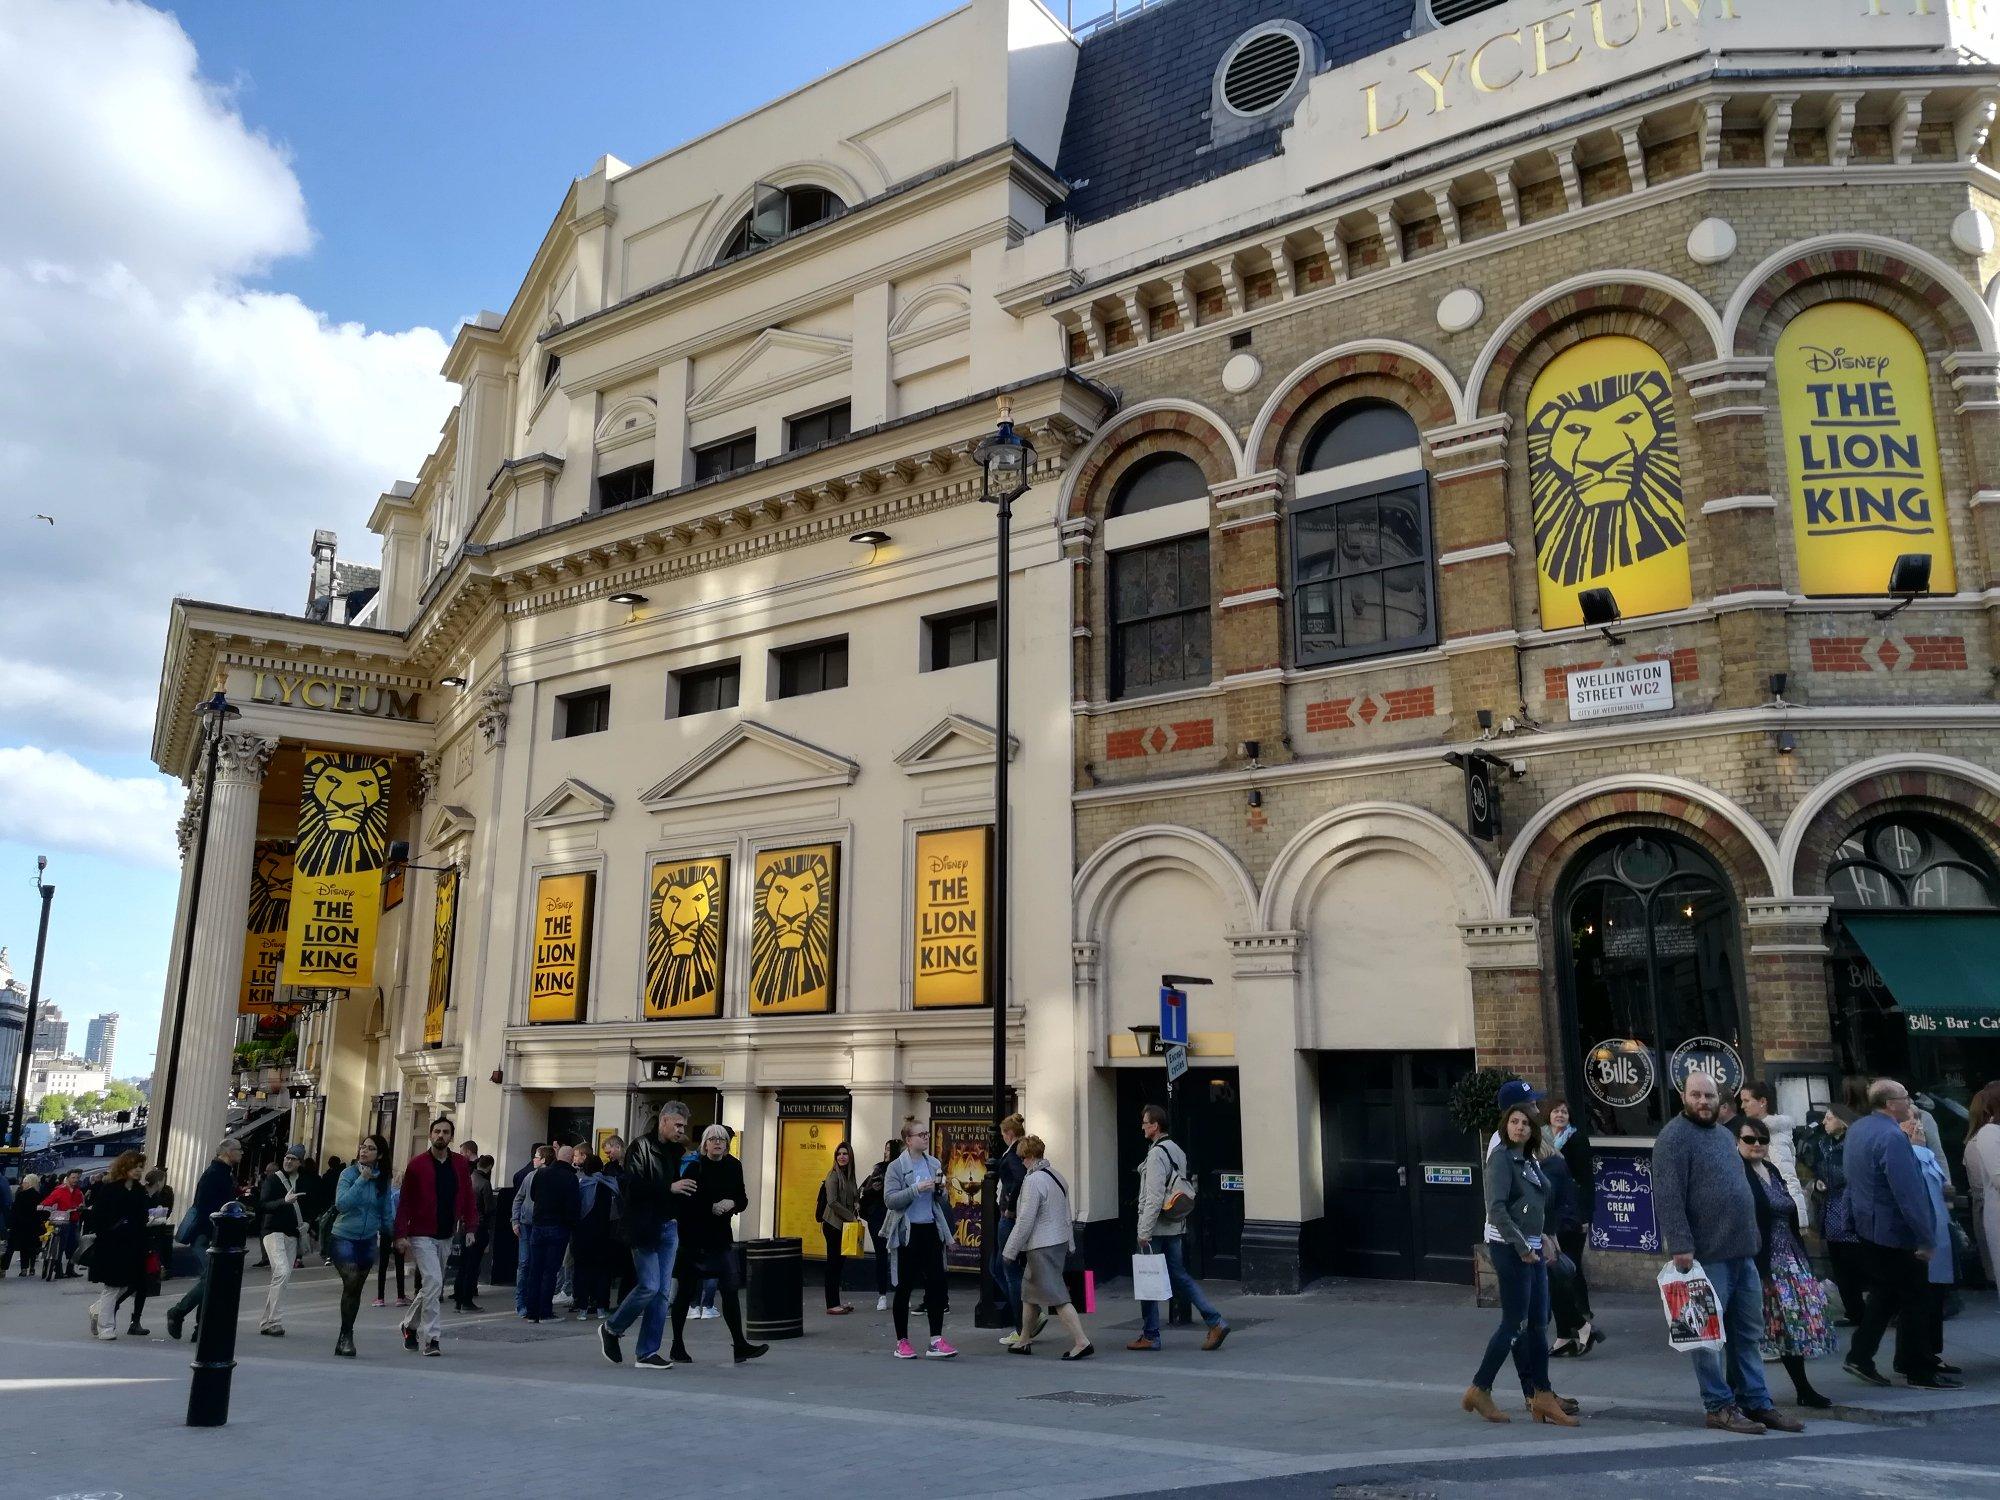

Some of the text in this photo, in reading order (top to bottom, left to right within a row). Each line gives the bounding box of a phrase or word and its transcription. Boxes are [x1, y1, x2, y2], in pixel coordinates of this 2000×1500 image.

[1799, 346, 1890, 378] Disney
[1806, 382, 1897, 417] THE
[1799, 434, 1921, 470] LION
[1803, 487, 1932, 524] KING
[1576, 666, 1662, 689] WELLINGTON
[251, 672, 422, 719] LYCEUM
[1577, 681, 1660, 704] STREET WC2
[1602, 703, 1645, 714] WESTMINSTER
[928, 855, 969, 874] Disney
[313, 881, 356, 899] Disney
[928, 876, 969, 901] THE
[313, 900, 354, 918] THE
[545, 897, 574, 913] Disney
[544, 915, 572, 935] THE
[922, 910, 976, 935] LION
[304, 924, 360, 943] LION
[260, 937, 286, 949] Disne
[259, 952, 278, 964] TH
[300, 950, 358, 968] KING
[537, 943, 576, 963] LION
[920, 944, 977, 969] KING
[251, 970, 276, 983] LIO
[535, 971, 575, 992] KING
[248, 989, 275, 1001] KIN
[1909, 1014, 1937, 1030] Bill's
[1946, 1017, 1970, 1029] Bar
[1700, 1039, 1721, 1049] Lunch
[1597, 1056, 1639, 1084] Bill's
[783, 1105, 845, 1113] LYCEUM THEATRE
[935, 1105, 966, 1114] LYCEUM
[1610, 1179, 1631, 1192] Bill's
[1607, 1202, 1636, 1213] CREAM
[1614, 1213, 1630, 1223] TEA
